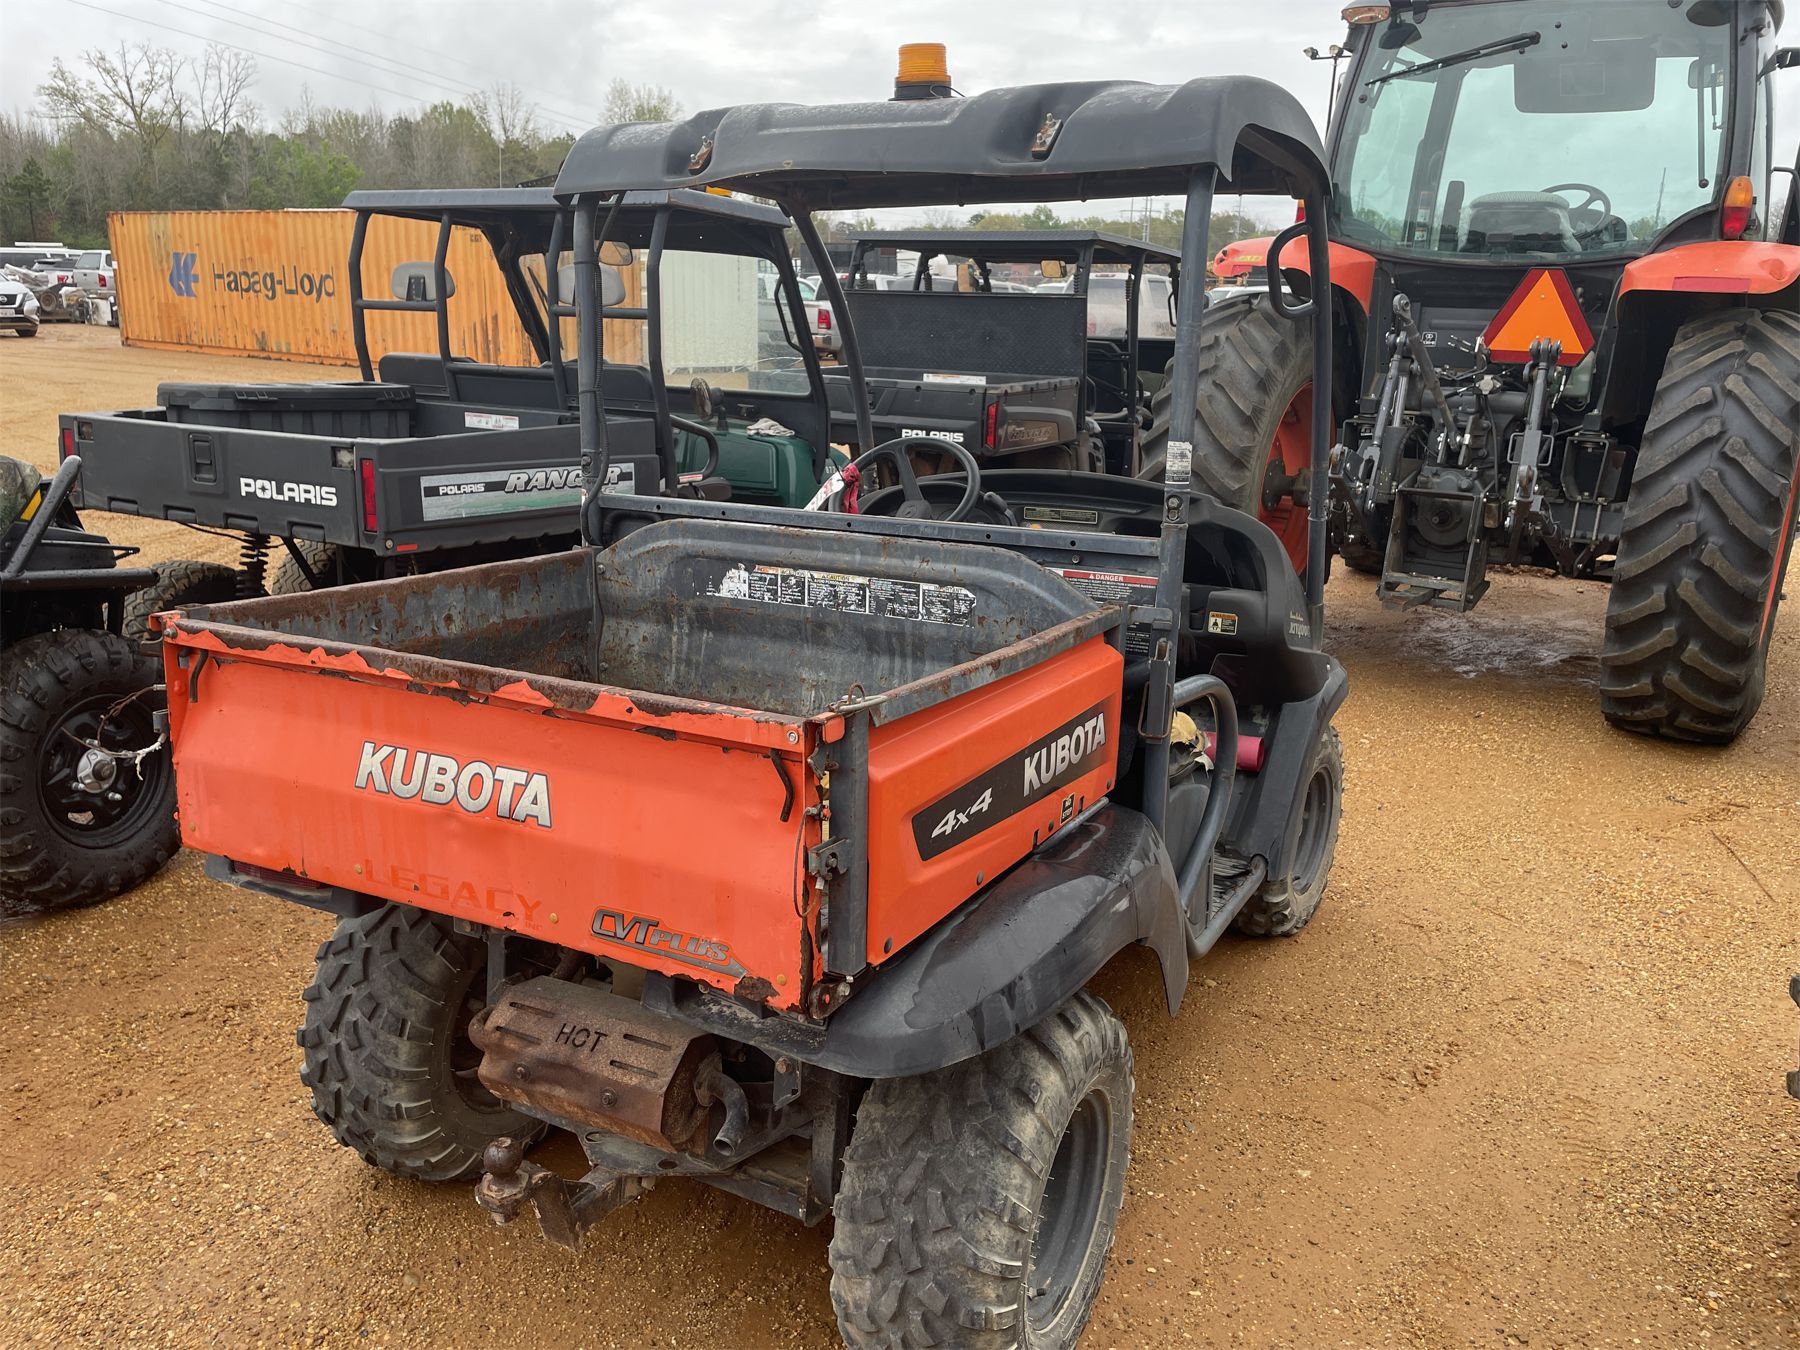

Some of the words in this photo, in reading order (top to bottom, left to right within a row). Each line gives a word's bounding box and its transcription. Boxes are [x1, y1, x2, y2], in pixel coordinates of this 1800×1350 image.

[212, 262, 336, 303] Hapag-Lloyd
[901, 429, 964, 442] POLARIS
[240, 478, 338, 507] POLARIS
[439, 484, 485, 496] POLARIS
[504, 465, 623, 494] RANGR
[1095, 574, 1124, 582] DANGER
[1023, 712, 1106, 797] KUBOTA
[354, 741, 552, 828] KUBOTA
[931, 787, 993, 838] 4x4
[365, 859, 542, 921] LEGACY
[592, 908, 659, 945] CVT
[649, 928, 731, 962] PLUS
[555, 1022, 609, 1053] HOT
